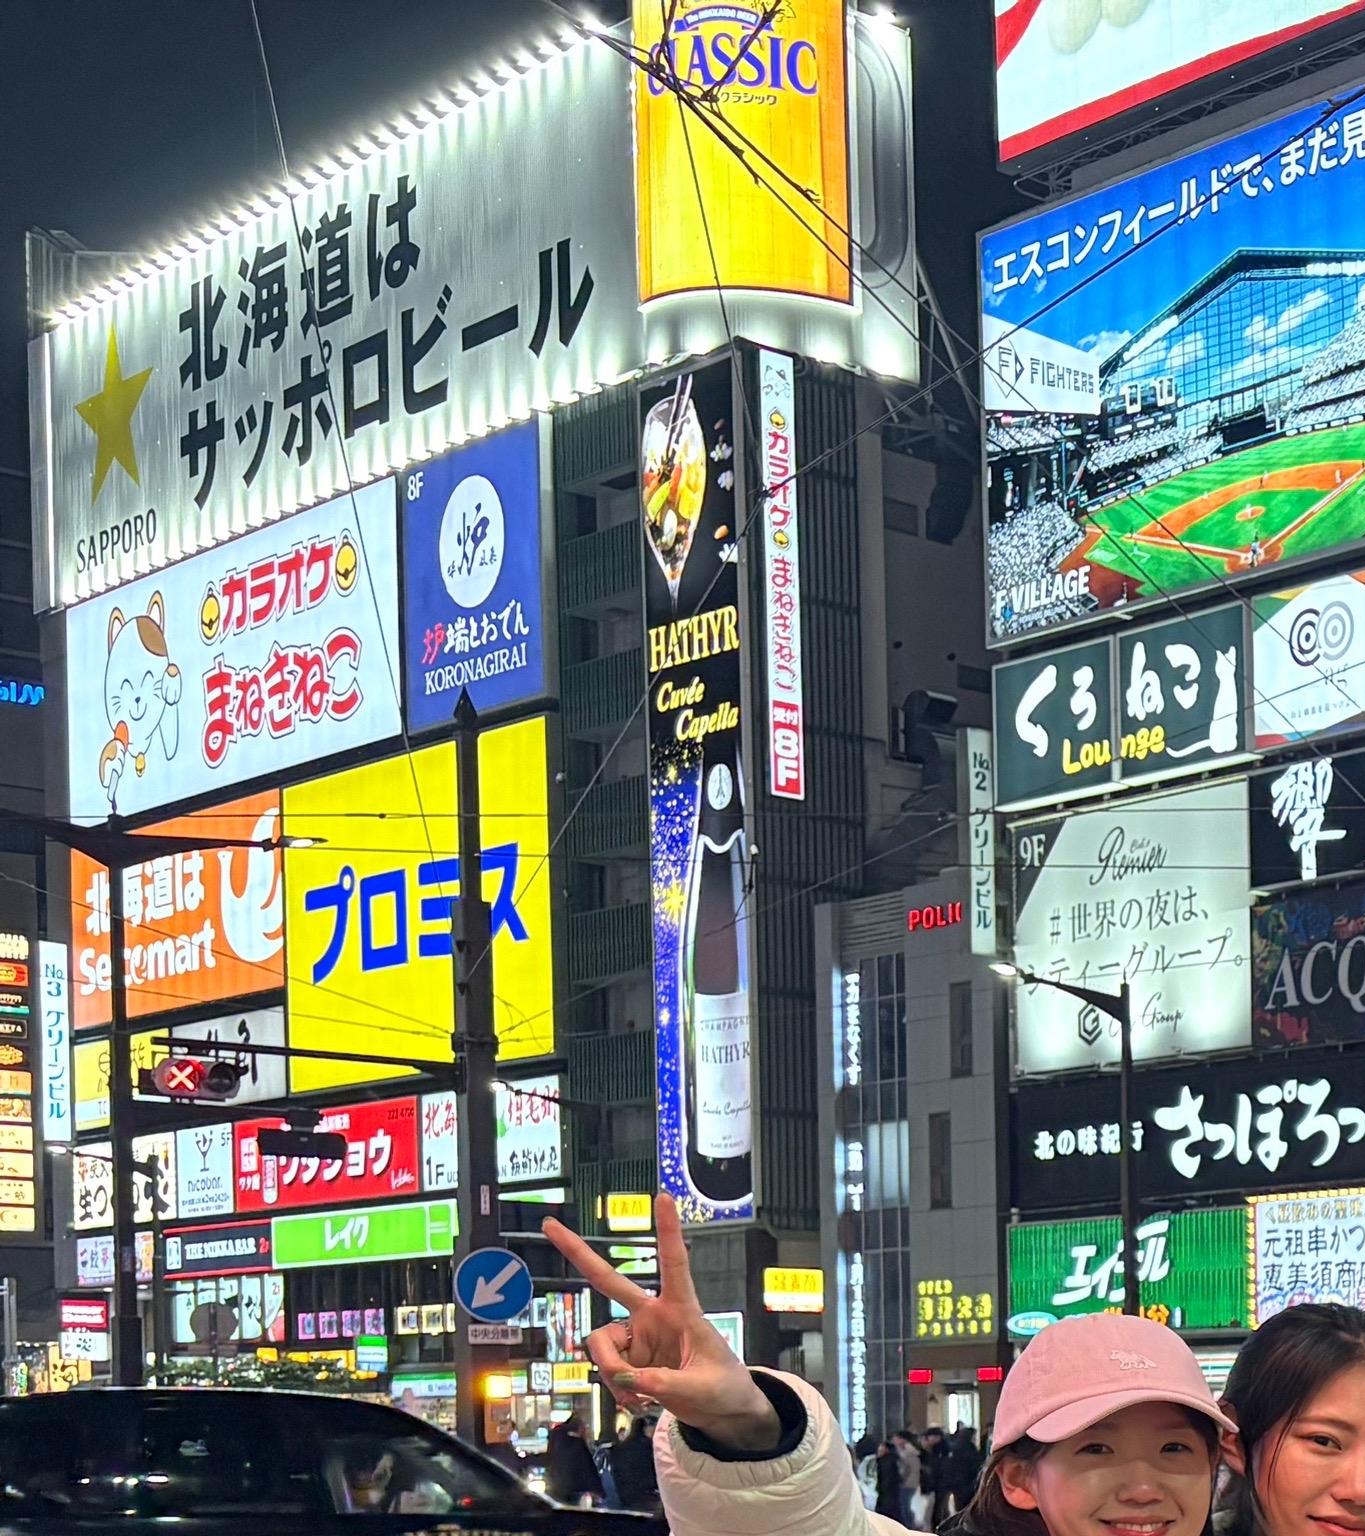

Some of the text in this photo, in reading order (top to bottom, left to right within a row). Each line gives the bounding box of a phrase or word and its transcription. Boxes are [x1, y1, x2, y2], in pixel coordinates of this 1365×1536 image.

[648, 32, 818, 96] CLASSIC
[179, 175, 420, 392] 北海道は
[180, 237, 594, 512] サッポロビール
[1030, 356, 1095, 394] FIGHTERS
[408, 471, 424, 501] 8F
[76, 507, 158, 575] SAPPORO
[218, 539, 338, 638] カラオケ
[1011, 565, 1091, 615] VILLAGE
[649, 605, 740, 673] HATHYR
[771, 554, 796, 692] まねきねこ
[200, 626, 364, 770] まねきねこ
[425, 642, 527, 696] KORONAGIRAI
[657, 676, 705, 713] Cuvée
[676, 701, 740, 742] Capella
[1015, 641, 1201, 758] くろねこ
[773, 729, 800, 787] 8F
[1062, 725, 1166, 775] Lounge
[1019, 833, 1046, 871] 9F
[86, 851, 206, 938] 北海道は
[305, 842, 529, 985] プロミス
[79, 920, 216, 996] Secomart
[425, 1155, 445, 1186] 1F
[323, 1215, 370, 1252] レイク
[1263, 1224, 1365, 1259] 元祖串かつ
[470, 1326, 521, 1341] 中央分離帯
